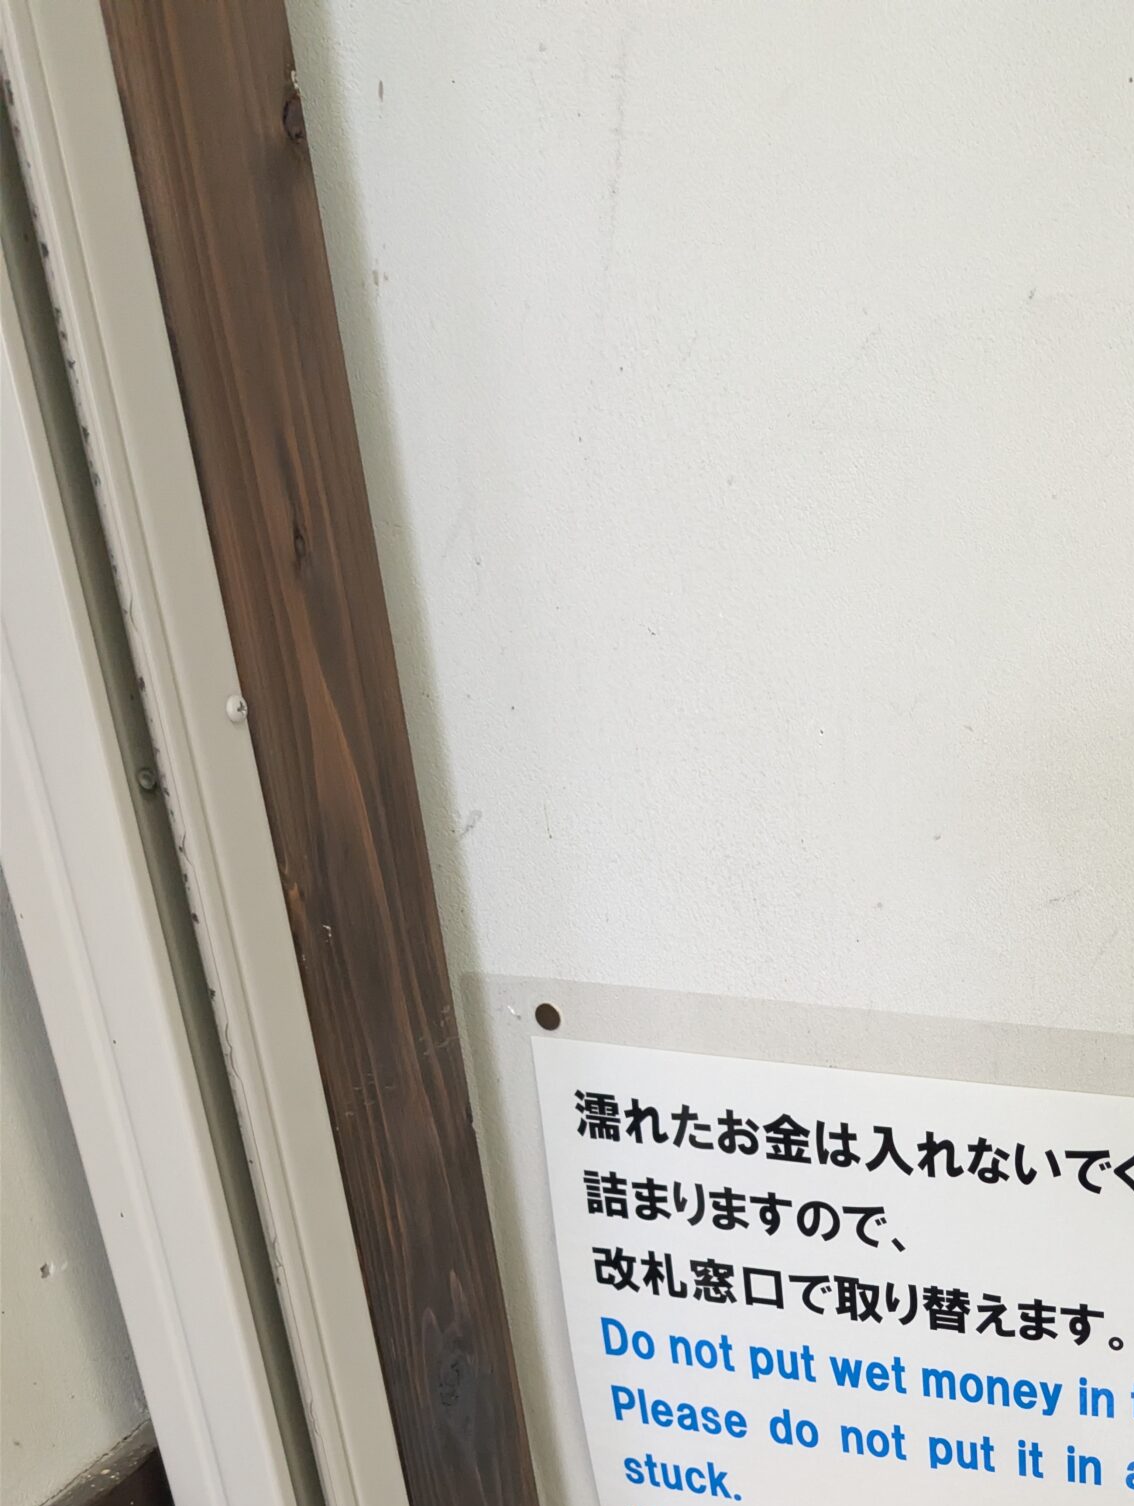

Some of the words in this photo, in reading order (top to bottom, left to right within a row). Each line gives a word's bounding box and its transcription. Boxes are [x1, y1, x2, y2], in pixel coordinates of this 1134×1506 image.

[583, 1169, 907, 1253] 詰まりますので、
[591, 1246, 1125, 1352] 改札窓口で取り替えます。
[600, 1315, 656, 1361] Do
[668, 1334, 736, 1373] not
[748, 1344, 817, 1383] put
[828, 1355, 908, 1395] wet
[921, 1367, 1063, 1417] money
[1078, 1376, 1115, 1419] in
[610, 1384, 748, 1439] Please
[768, 1408, 820, 1449] do
[840, 1423, 908, 1461] not
[927, 1435, 996, 1473] put
[1017, 1438, 1044, 1479] it
[1065, 1444, 1103, 1486] in
[623, 1453, 743, 1503] stuck.
